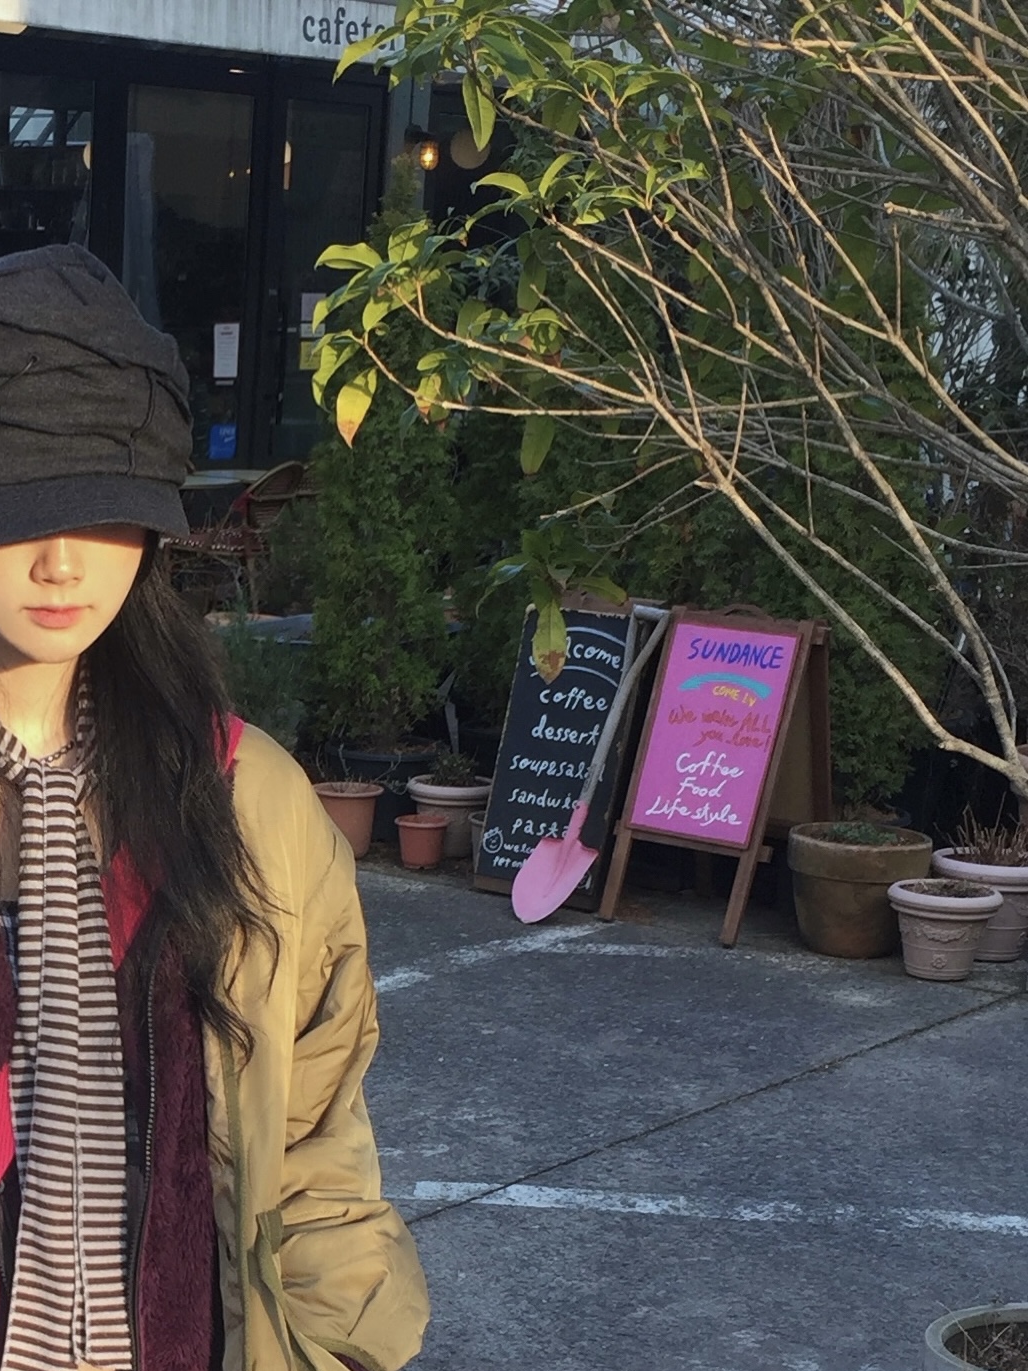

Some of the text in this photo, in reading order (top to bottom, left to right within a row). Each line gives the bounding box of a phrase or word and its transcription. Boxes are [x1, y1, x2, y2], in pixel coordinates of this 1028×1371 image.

[302, 7, 396, 51] cafet
[688, 638, 784, 669] SUNDANCE
[539, 686, 609, 712] coffee
[712, 685, 740, 701] COME
[531, 714, 600, 746] dessert
[675, 751, 745, 778] Coffee
[676, 776, 727, 798] Food
